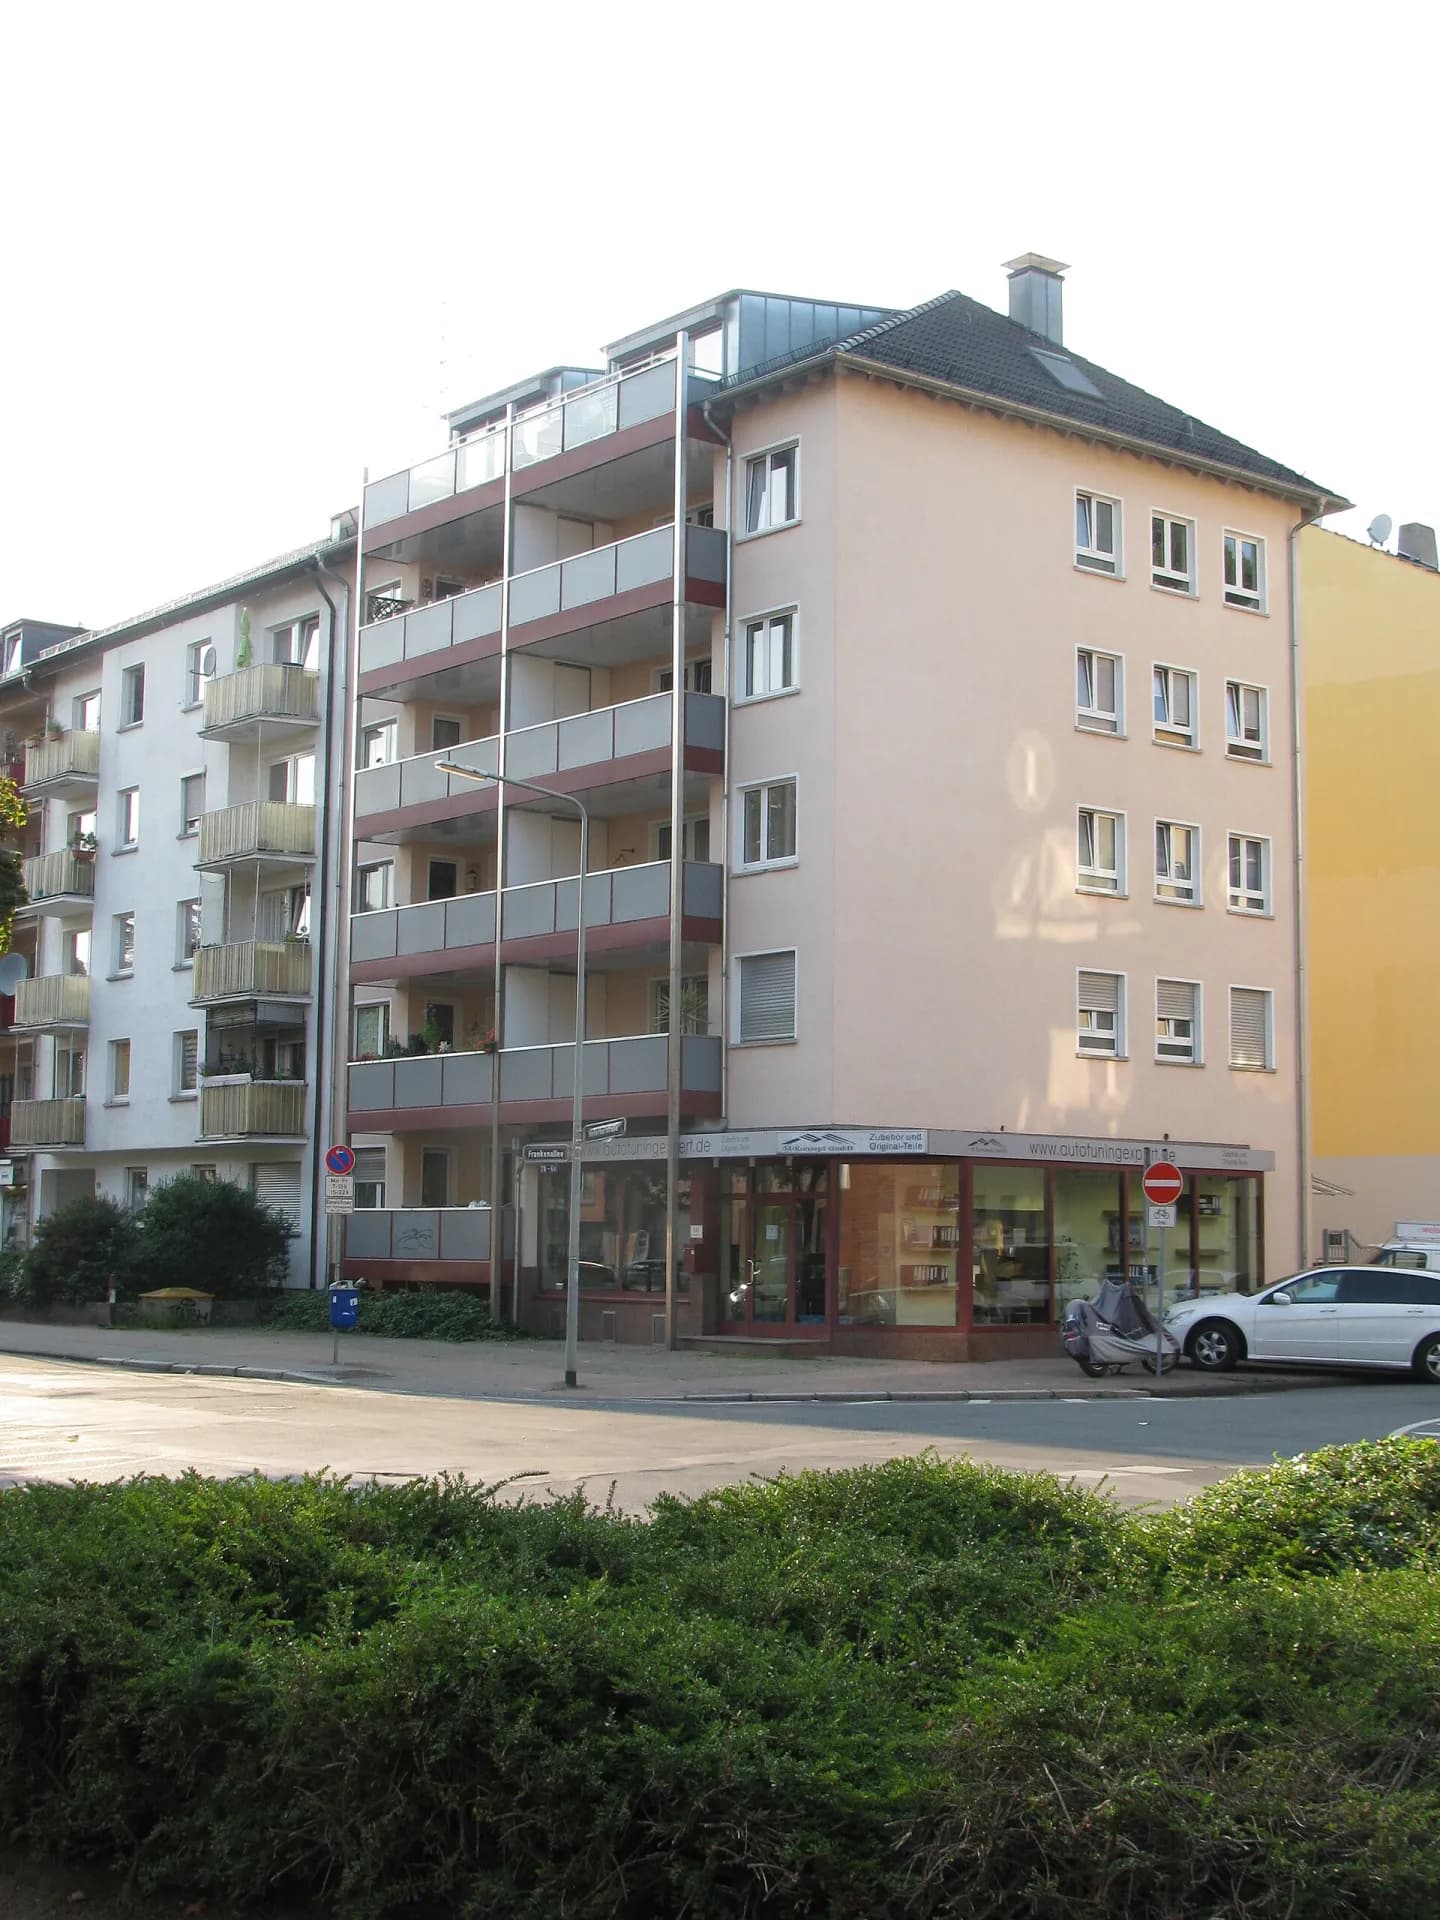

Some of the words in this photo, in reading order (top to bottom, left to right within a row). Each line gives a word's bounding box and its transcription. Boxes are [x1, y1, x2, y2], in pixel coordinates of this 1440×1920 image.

[906, 1133, 922, 1141] und
[581, 1139, 711, 1157] www.autotuningeert.de
[869, 1142, 923, 1152] Original-Teile
[1029, 1142, 1176, 1162] www.autotuningexprt.e
